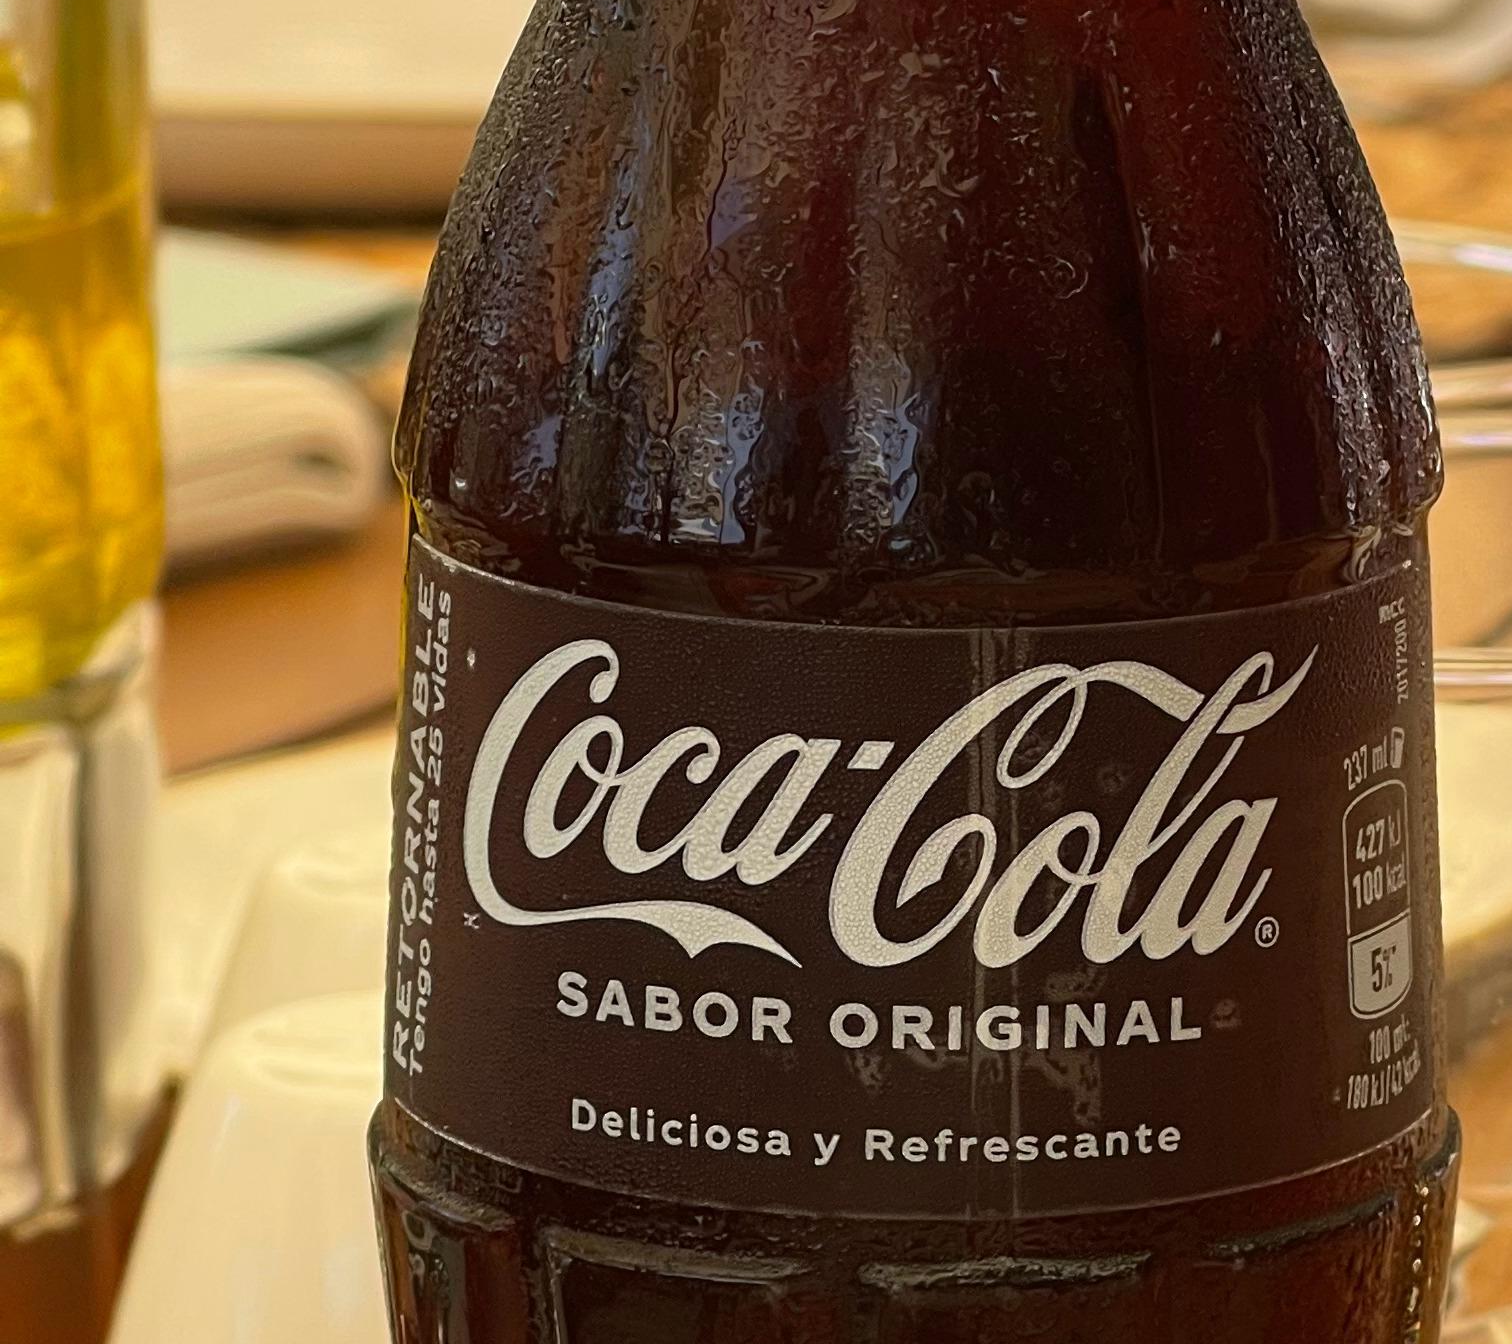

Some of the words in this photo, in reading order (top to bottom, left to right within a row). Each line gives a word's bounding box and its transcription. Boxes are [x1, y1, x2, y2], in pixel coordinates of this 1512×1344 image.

[431, 590, 451, 712] vidas
[463, 639, 1319, 968] Coca-Cola
[1343, 744, 1368, 791] 237
[393, 573, 435, 1068] RETORNABLE
[1356, 819, 1385, 863] 427
[419, 799, 440, 925] hasta
[1352, 865, 1384, 908] 100
[410, 938, 432, 1076] Tengo
[556, 971, 793, 1045] SABOR
[829, 996, 1202, 1051] ORIGINAL
[1369, 1025, 1390, 1064] 100
[571, 1098, 792, 1156] Deliciosa
[813, 1132, 841, 1166] y
[864, 1123, 1181, 1163] Refrescante
